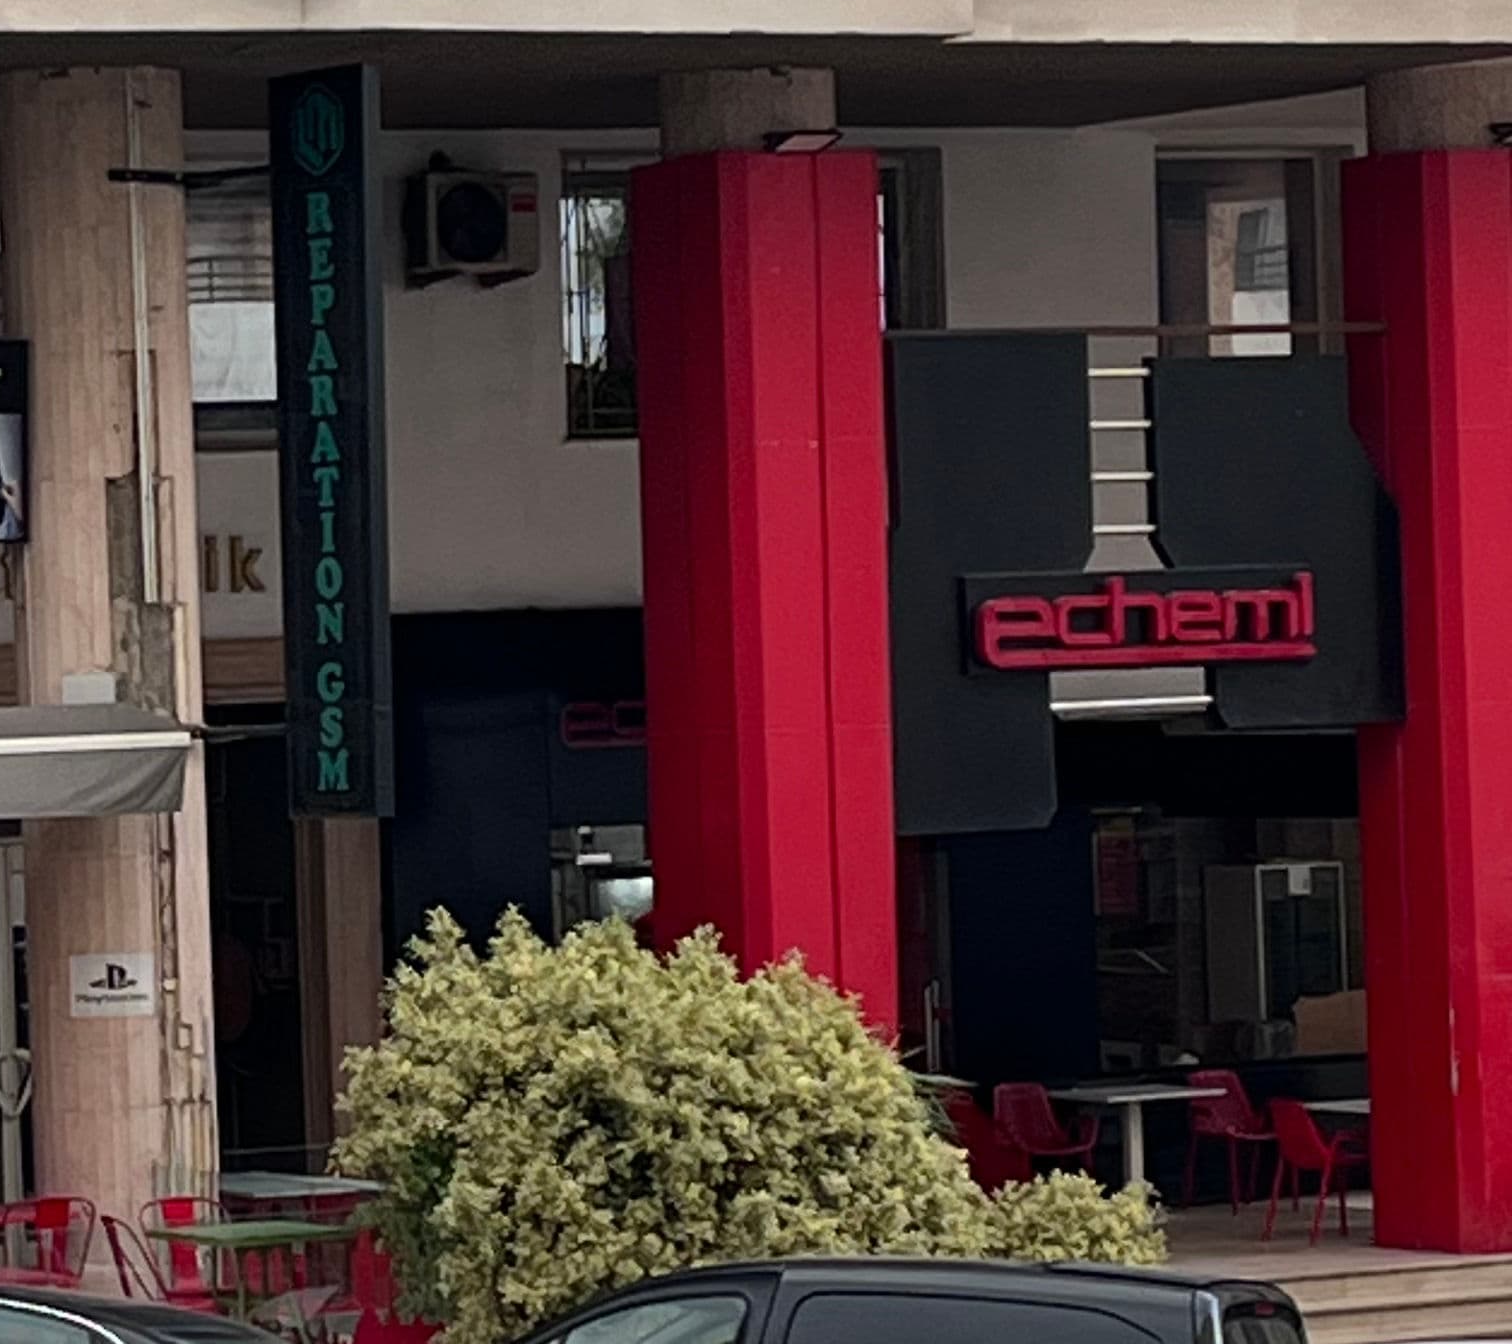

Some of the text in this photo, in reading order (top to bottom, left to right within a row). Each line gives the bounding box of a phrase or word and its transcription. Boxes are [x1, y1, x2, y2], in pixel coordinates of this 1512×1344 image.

[305, 191, 344, 644] REPARATION
[975, 570, 1318, 672] echemi
[316, 661, 350, 792] GSM
